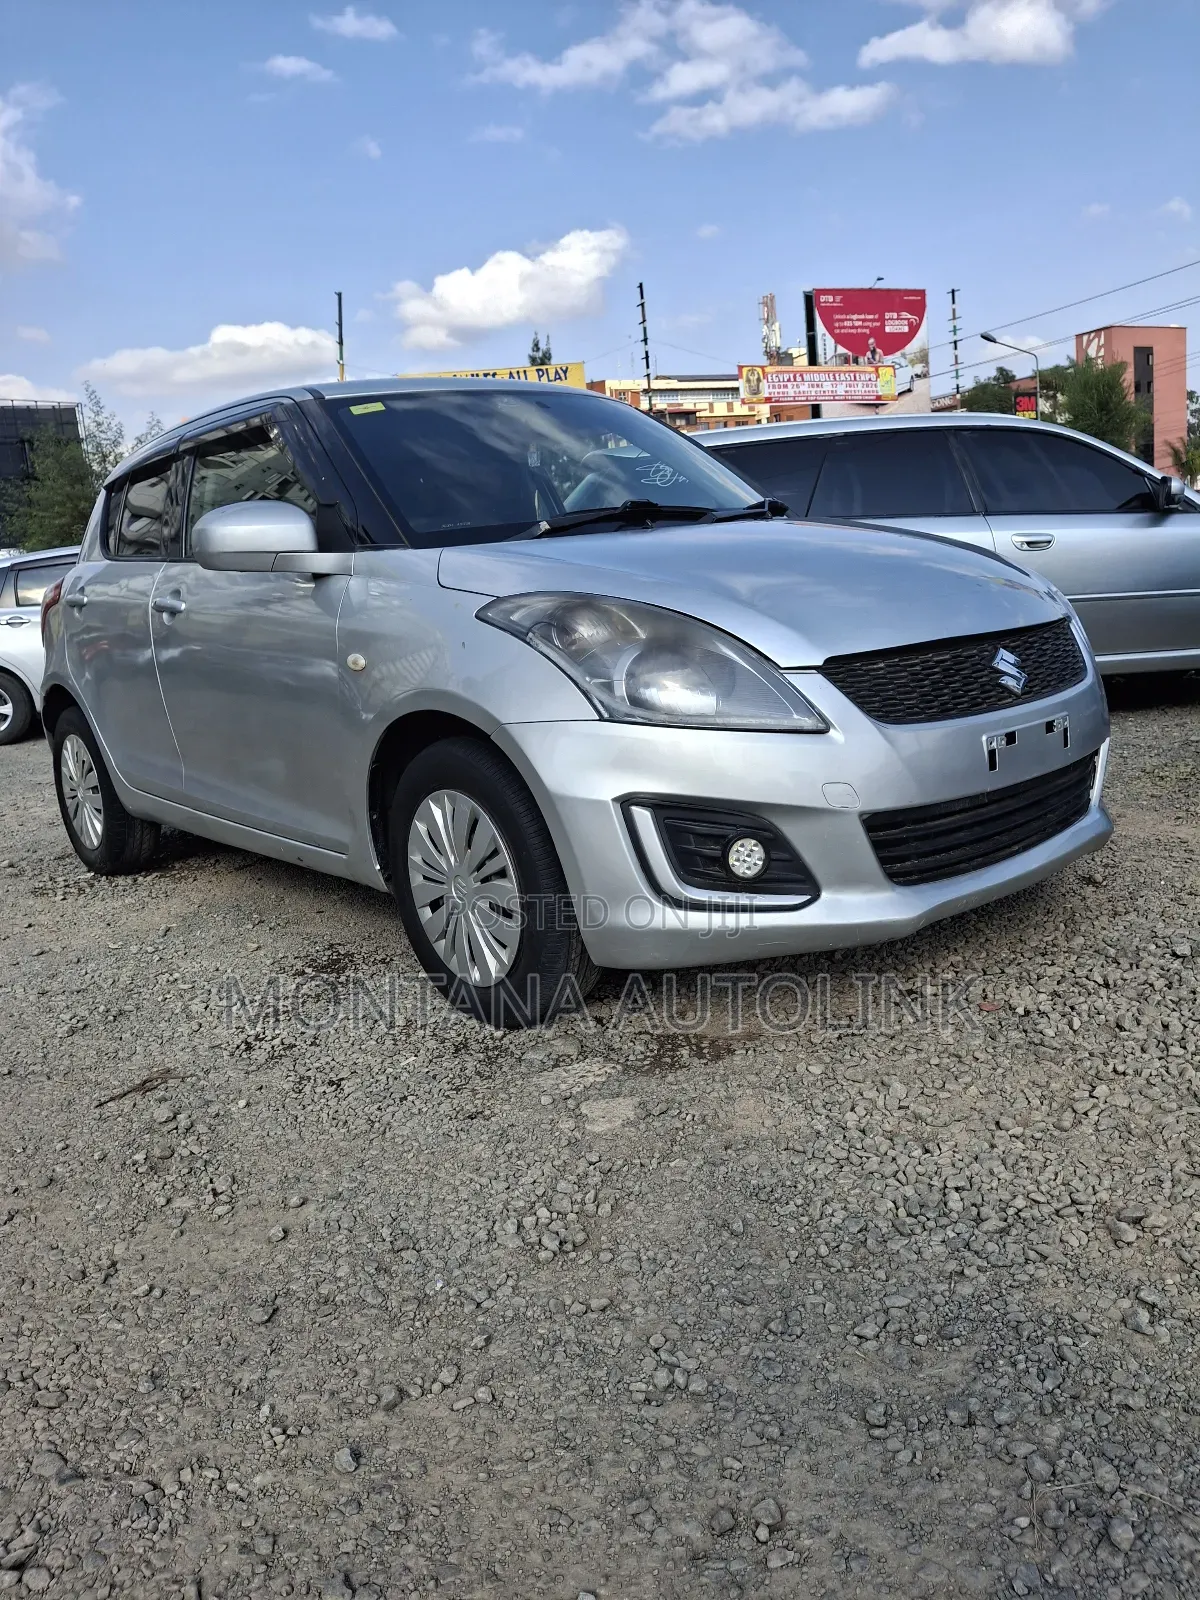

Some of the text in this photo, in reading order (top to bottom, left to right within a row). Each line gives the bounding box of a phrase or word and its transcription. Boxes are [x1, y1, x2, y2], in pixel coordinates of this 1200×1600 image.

[536, 366, 569, 382] PLAY
[768, 374, 794, 383] EGYPT
[798, 374, 802, 382] &
[804, 374, 833, 382] MIDDLE
[836, 373, 855, 382] EAST
[856, 373, 877, 382] EXPO
[1016, 396, 1036, 411] 3M
